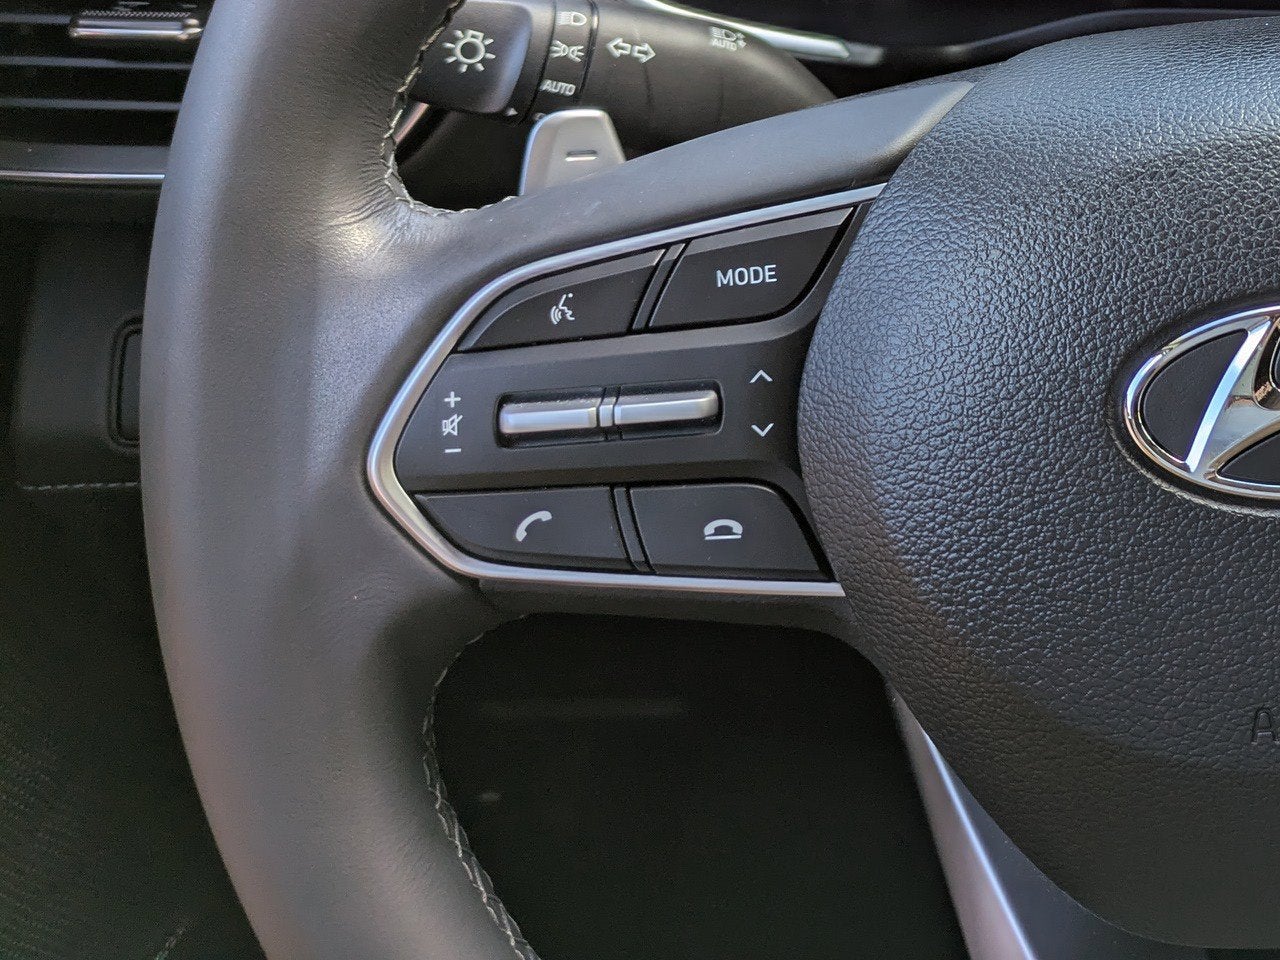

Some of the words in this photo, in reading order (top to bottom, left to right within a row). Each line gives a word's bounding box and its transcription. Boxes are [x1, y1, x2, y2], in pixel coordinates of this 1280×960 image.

[712, 38, 737, 51] AUTO
[541, 79, 576, 96] AUTO
[716, 264, 778, 288] MODE
